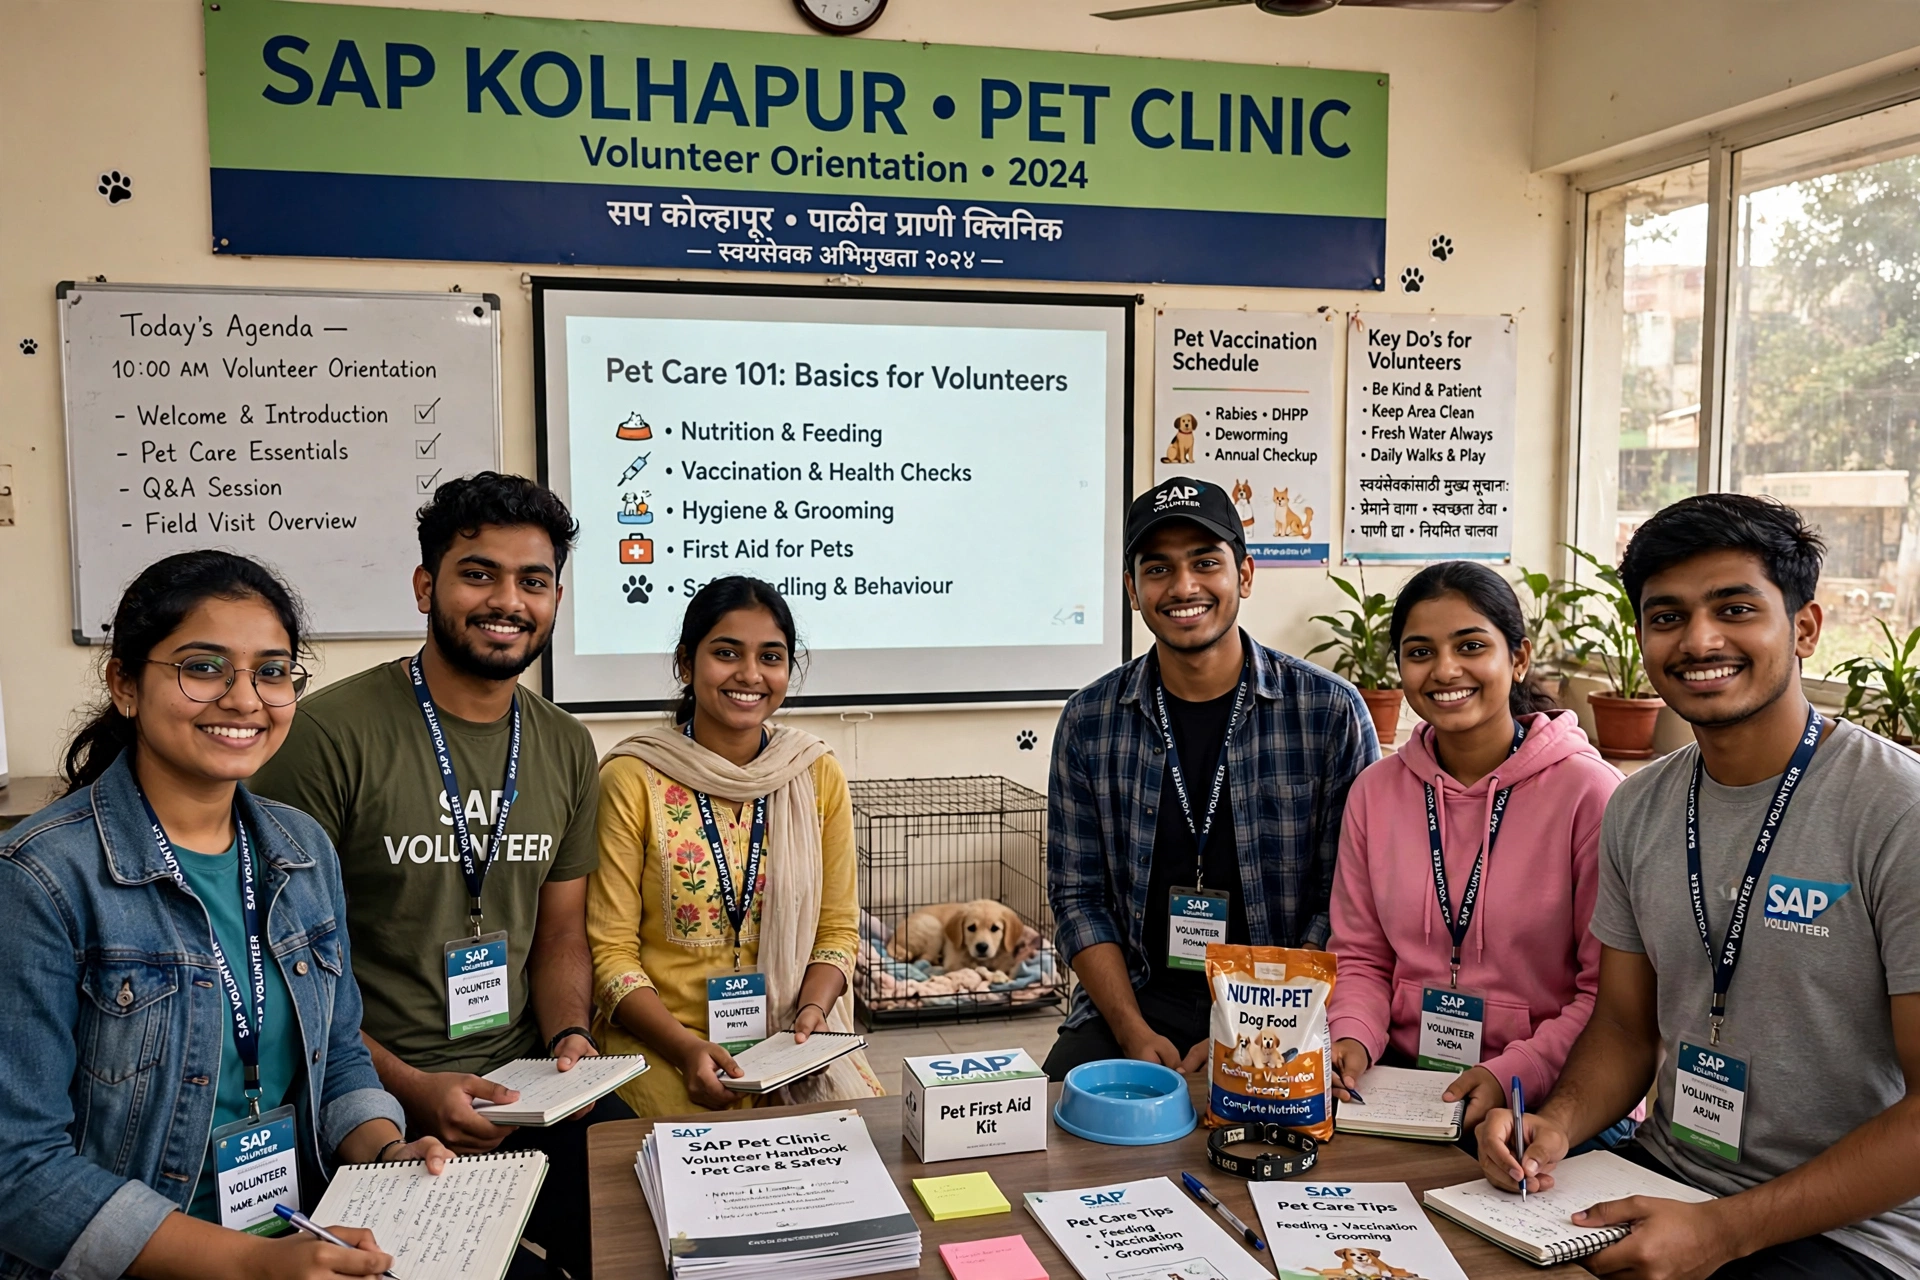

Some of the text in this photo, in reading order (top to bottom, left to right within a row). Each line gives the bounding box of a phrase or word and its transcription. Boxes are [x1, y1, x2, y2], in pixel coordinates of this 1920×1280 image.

[261, 34, 1352, 159] SAP KOLHAPUR PET CLINIC
[580, 135, 1089, 189] Volunteer Orientation 2024
[607, 195, 1063, 242] सप कोल्हापूर पाळीव प्राणी क्लिनिक
[718, 238, 975, 273] स्वयंसेवक अभिमुखता २०२४
[120, 312, 313, 348] Today's Agenda
[1173, 329, 1317, 350] Pet Vaccination
[1369, 329, 1473, 352] Key Do's for
[112, 357, 437, 379] 10:00 AM Volunteer Orientation
[1173, 353, 1260, 372] Schedule
[1369, 352, 1462, 371] Volunteers
[606, 357, 1068, 392] Pet Care 101: Basics for Volunteers
[1372, 383, 1482, 399] Be Kind & Patient
[138, 403, 388, 426] Welcome & Introduction
[1215, 407, 1309, 422] Rabies DHPP
[1372, 404, 1474, 421] Keep Area Clean
[681, 421, 882, 446] Nutrition & Feeding
[1215, 428, 1288, 443] Deworming
[1371, 427, 1493, 443] Fresh Water Always
[142, 440, 349, 463] Pet Care Essentials
[1215, 448, 1319, 466] Annual Checkup
[1371, 449, 1486, 466] Daily Walks & Play
[681, 461, 972, 483] Vaccination & Health Checks
[143, 476, 282, 500] Q&A Session
[1360, 474, 1440, 492] स्वयंसेवकांसाठी
[1444, 479, 1469, 496] मुख्य
[1155, 486, 1198, 505] SAP
[682, 501, 894, 524] Hygiene & Grooming
[1153, 500, 1200, 512] VOLUNTEER
[1360, 498, 1389, 516] प्रेमाने
[1393, 503, 1418, 516] वागा
[1478, 499, 1498, 516] ठेवा
[146, 510, 356, 534] Field Visit Overview
[1361, 521, 1387, 538] पाणी
[1391, 525, 1405, 538] द्या
[1419, 521, 1461, 538] नियमित
[682, 540, 853, 559] First Aid for Pets
[768, 576, 953, 600] dling & Behaviour
[1757, 766, 1801, 853] SAP VOLUNTEER
[1187, 899, 1209, 910] SAP
[1767, 883, 1829, 919] SAP
[1723, 874, 1755, 966] SAP VOLUNTEER
[1763, 916, 1830, 938] VOLUNTEER
[1175, 925, 1219, 937] VOLUNTEER
[466, 948, 489, 963] SAP
[455, 978, 501, 995] VOLUNTEER
[725, 978, 749, 990] SAP
[1228, 983, 1312, 1008] NUTRI-PET
[1441, 994, 1465, 1009] SAP
[714, 1006, 760, 1018] VOLUNTEER
[1239, 1012, 1297, 1030] Dog Food
[1427, 1022, 1475, 1040] VOLUNTEER
[929, 1055, 1012, 1077] SAP
[1698, 1052, 1725, 1071] SAP
[1682, 1084, 1734, 1112] VOLUNTEER
[941, 1096, 1031, 1120] Pet First Aid
[1693, 1105, 1720, 1123] ARJUN
[671, 1128, 707, 1137] SAP
[977, 1120, 997, 1134] Kit
[240, 1129, 271, 1152] SAP
[689, 1133, 831, 1151] SAP Pet Clinic
[682, 1144, 849, 1165] Volunteer Handbook
[702, 1156, 842, 1175] Pet Care & Safety
[229, 1166, 287, 1195] VOLUNTEER
[1080, 1190, 1126, 1206] SAP
[1305, 1187, 1351, 1197] SAP
[1067, 1206, 1174, 1228] Pet Care Tips
[1278, 1202, 1397, 1213] Pet Care Tips
[1100, 1223, 1155, 1238] Feeding
[1277, 1221, 1418, 1231] Feeding Vaccination
[1104, 1232, 1183, 1249] Vaccination
[1326, 1232, 1391, 1242] Grooming
[1115, 1242, 1184, 1259] Grooming
